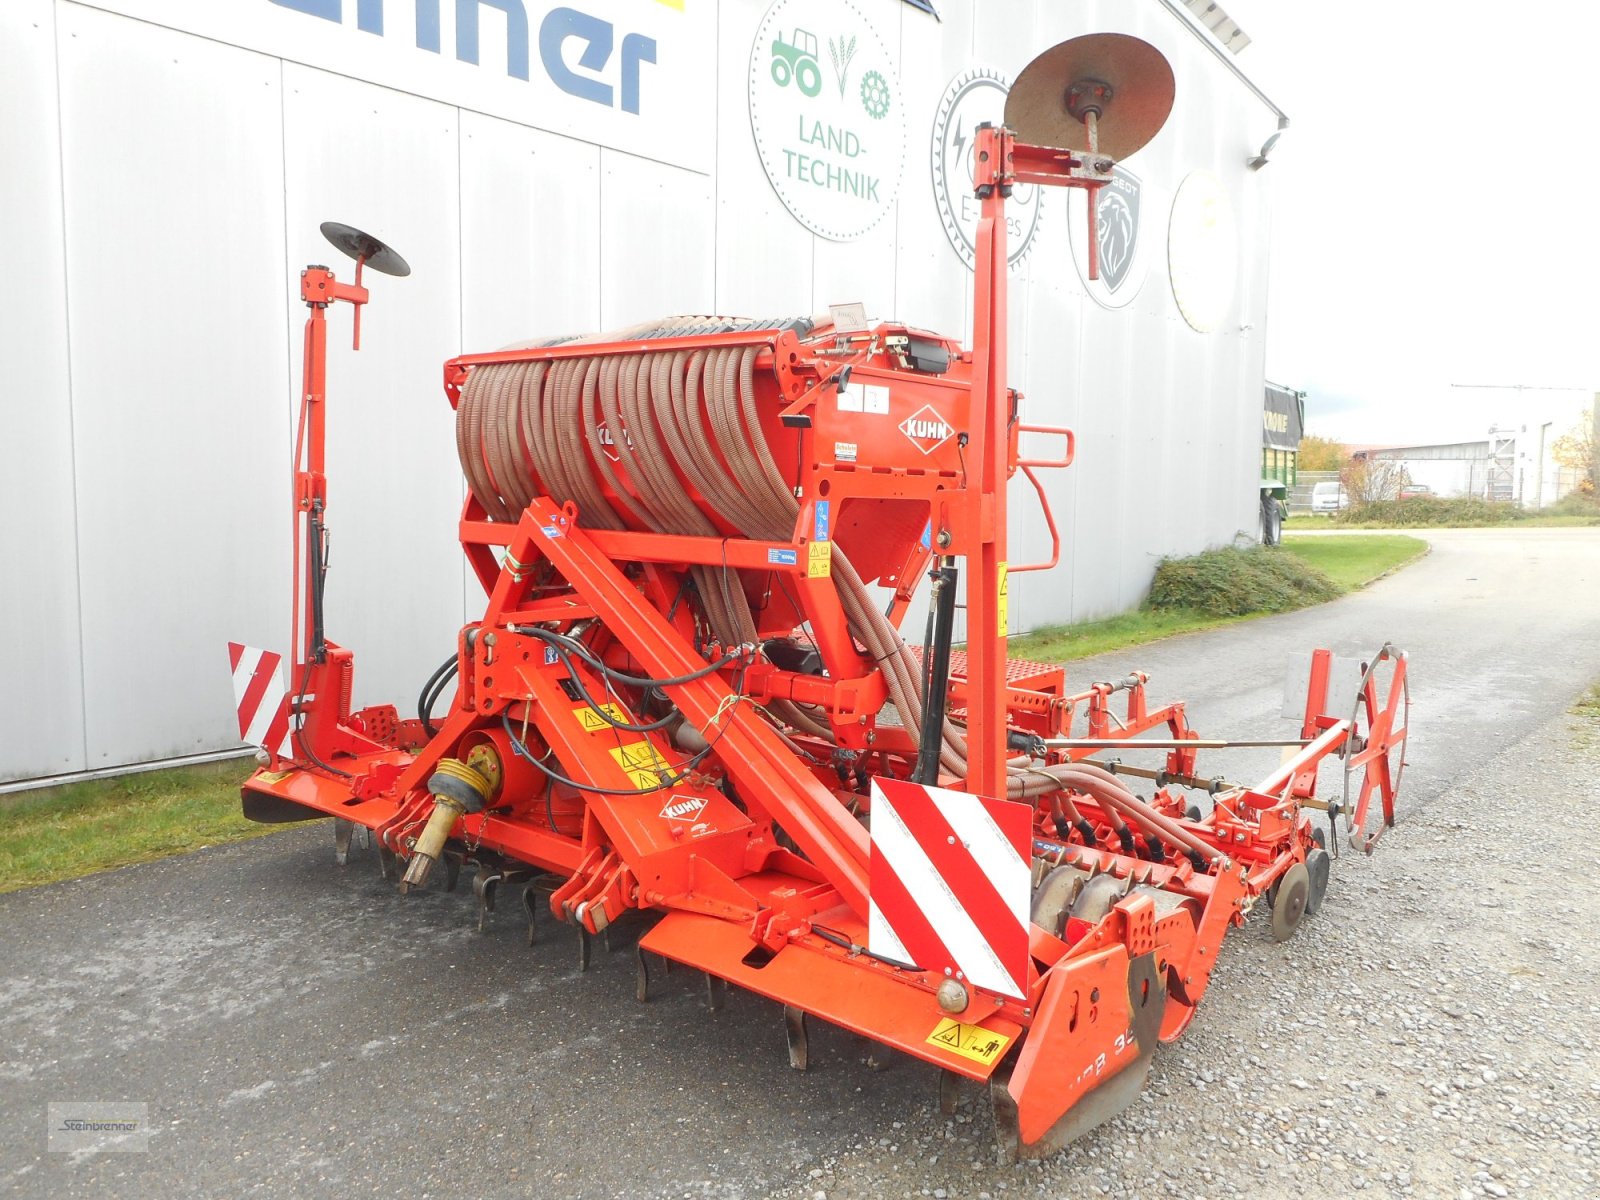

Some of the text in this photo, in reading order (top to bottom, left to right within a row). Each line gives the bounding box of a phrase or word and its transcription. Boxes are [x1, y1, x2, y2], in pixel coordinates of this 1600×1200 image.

[799, 113, 868, 159] LAND-
[781, 148, 881, 204] TECHNIK
[1112, 175, 1138, 197] GEOT
[961, 194, 1022, 238] E-es
[906, 418, 948, 441] KUHN
[664, 798, 704, 819] KUHN
